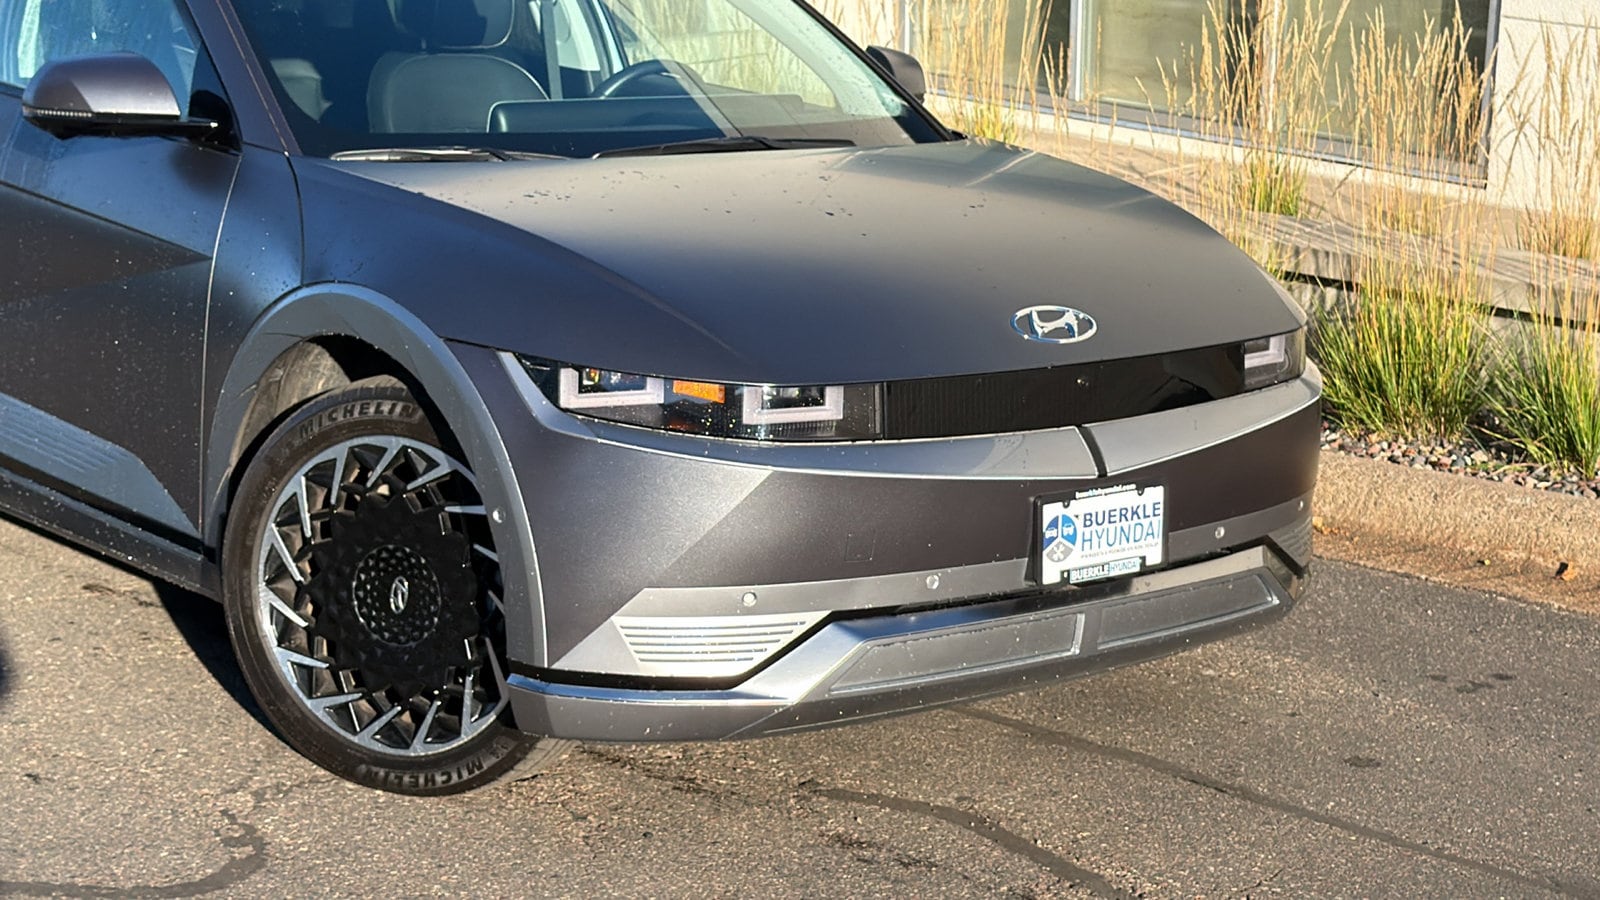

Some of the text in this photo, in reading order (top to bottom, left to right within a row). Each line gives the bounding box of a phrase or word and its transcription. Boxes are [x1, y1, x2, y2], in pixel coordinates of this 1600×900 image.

[298, 401, 415, 438] MICHELIN
[1083, 501, 1161, 528] BUERKLE
[1081, 519, 1161, 552] HYUNDAI
[1071, 563, 1109, 581] BUERKLE
